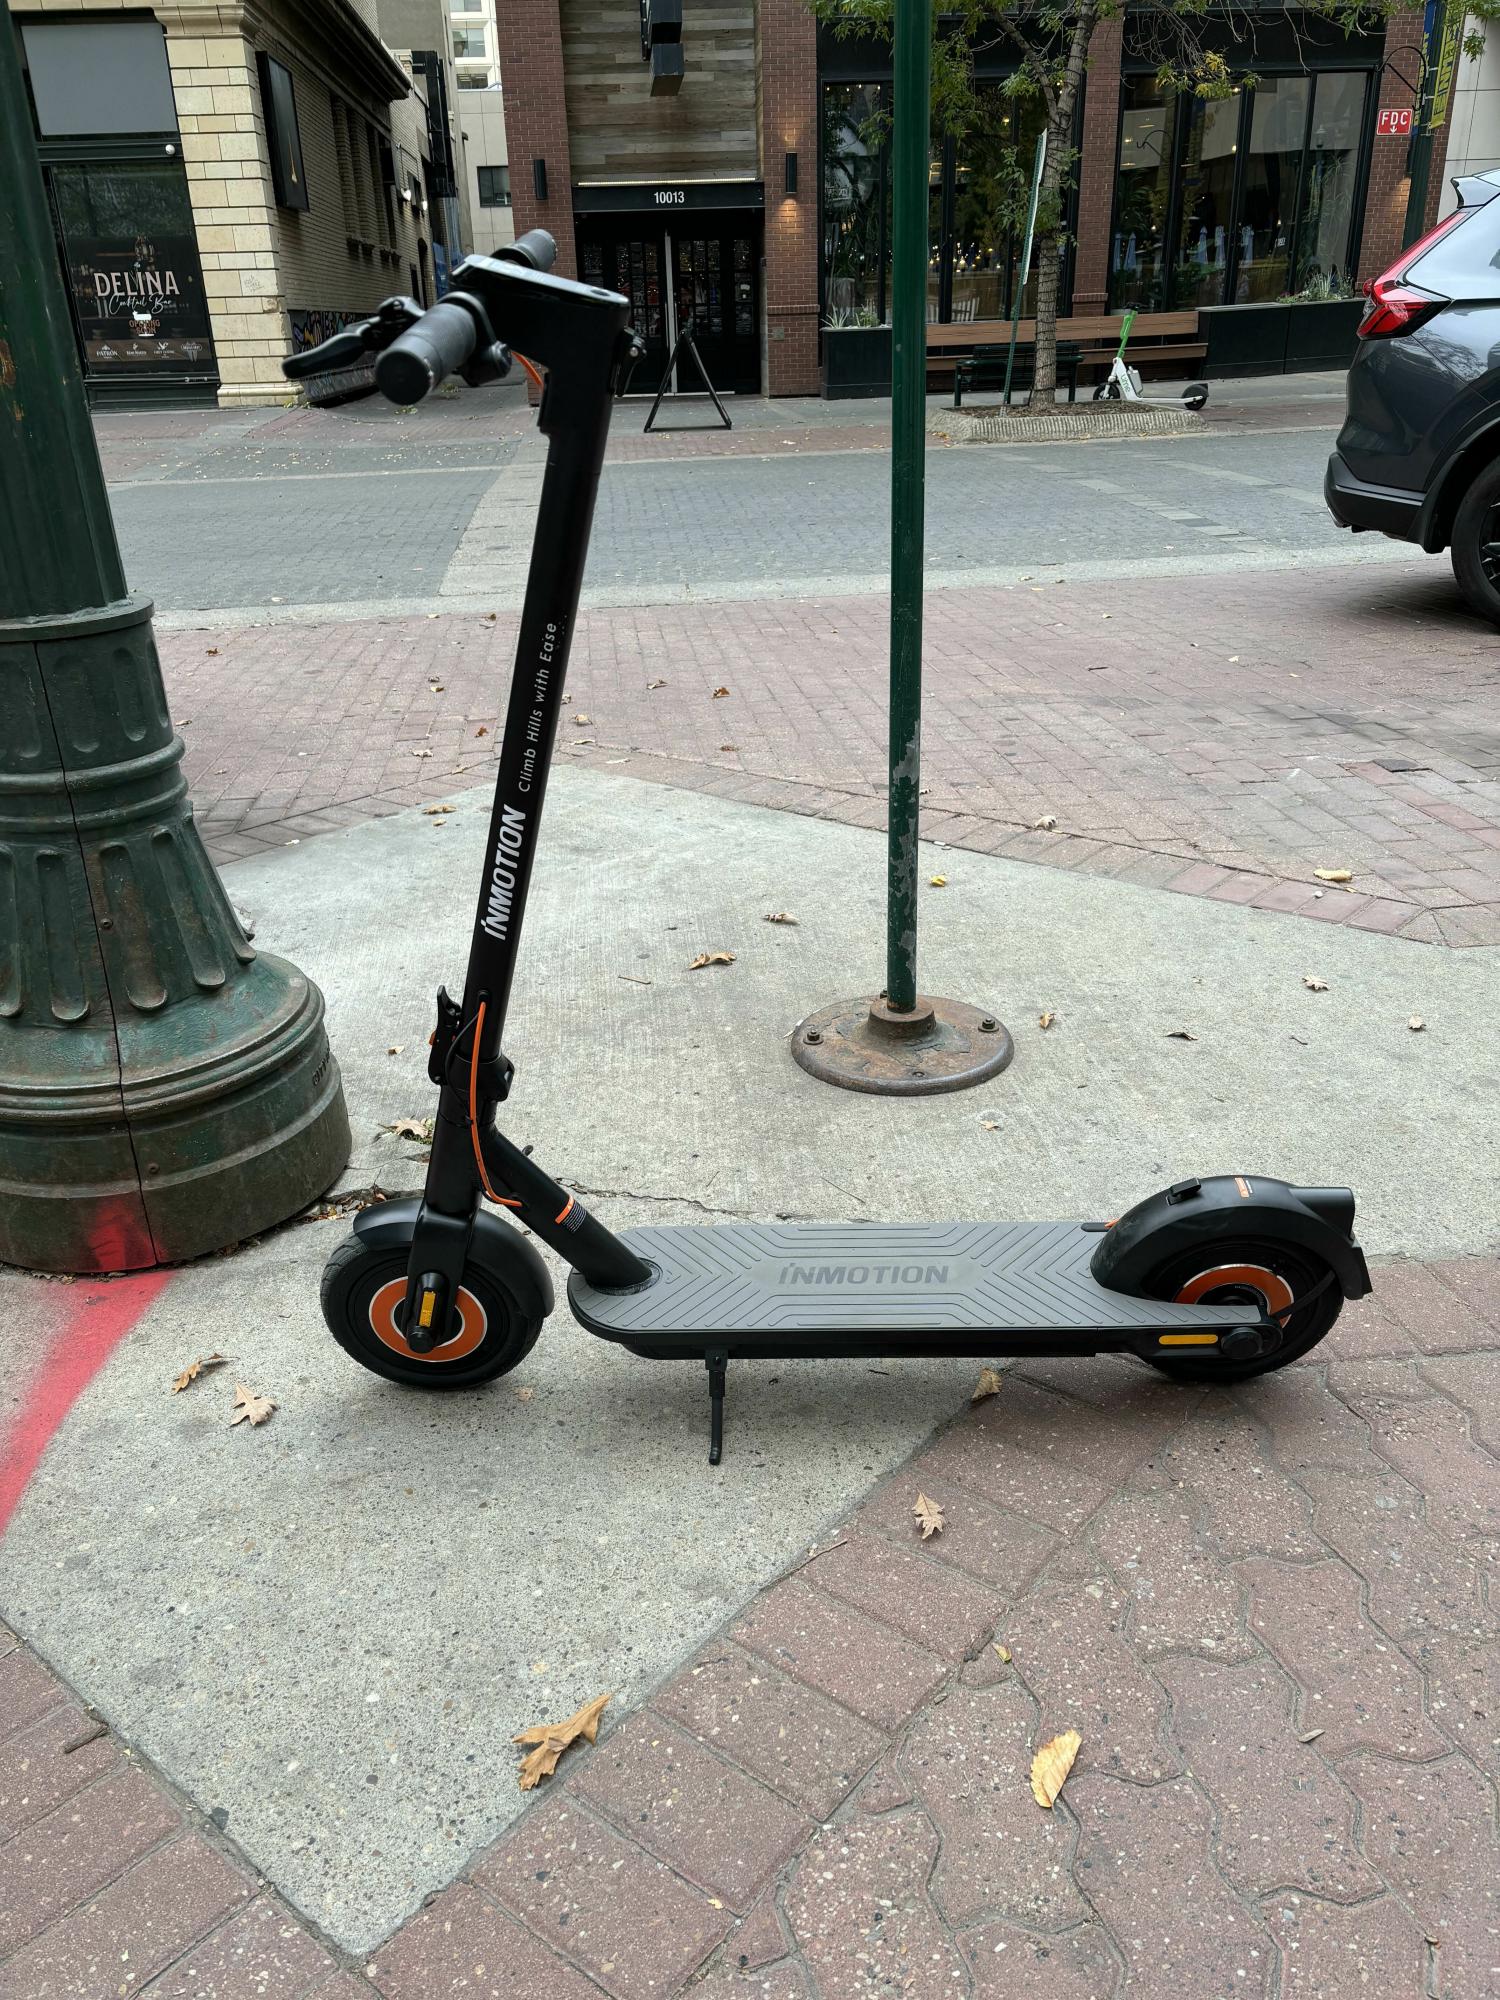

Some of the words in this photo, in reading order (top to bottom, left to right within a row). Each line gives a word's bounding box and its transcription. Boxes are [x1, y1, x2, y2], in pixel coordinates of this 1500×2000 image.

[1381, 111, 1408, 125] FDC
[653, 191, 685, 204] 10013
[94, 271, 180, 296] DELINA
[539, 622, 557, 662] Ease
[534, 668, 550, 702] with
[526, 710, 543, 743] Hills
[518, 749, 536, 792] Climb
